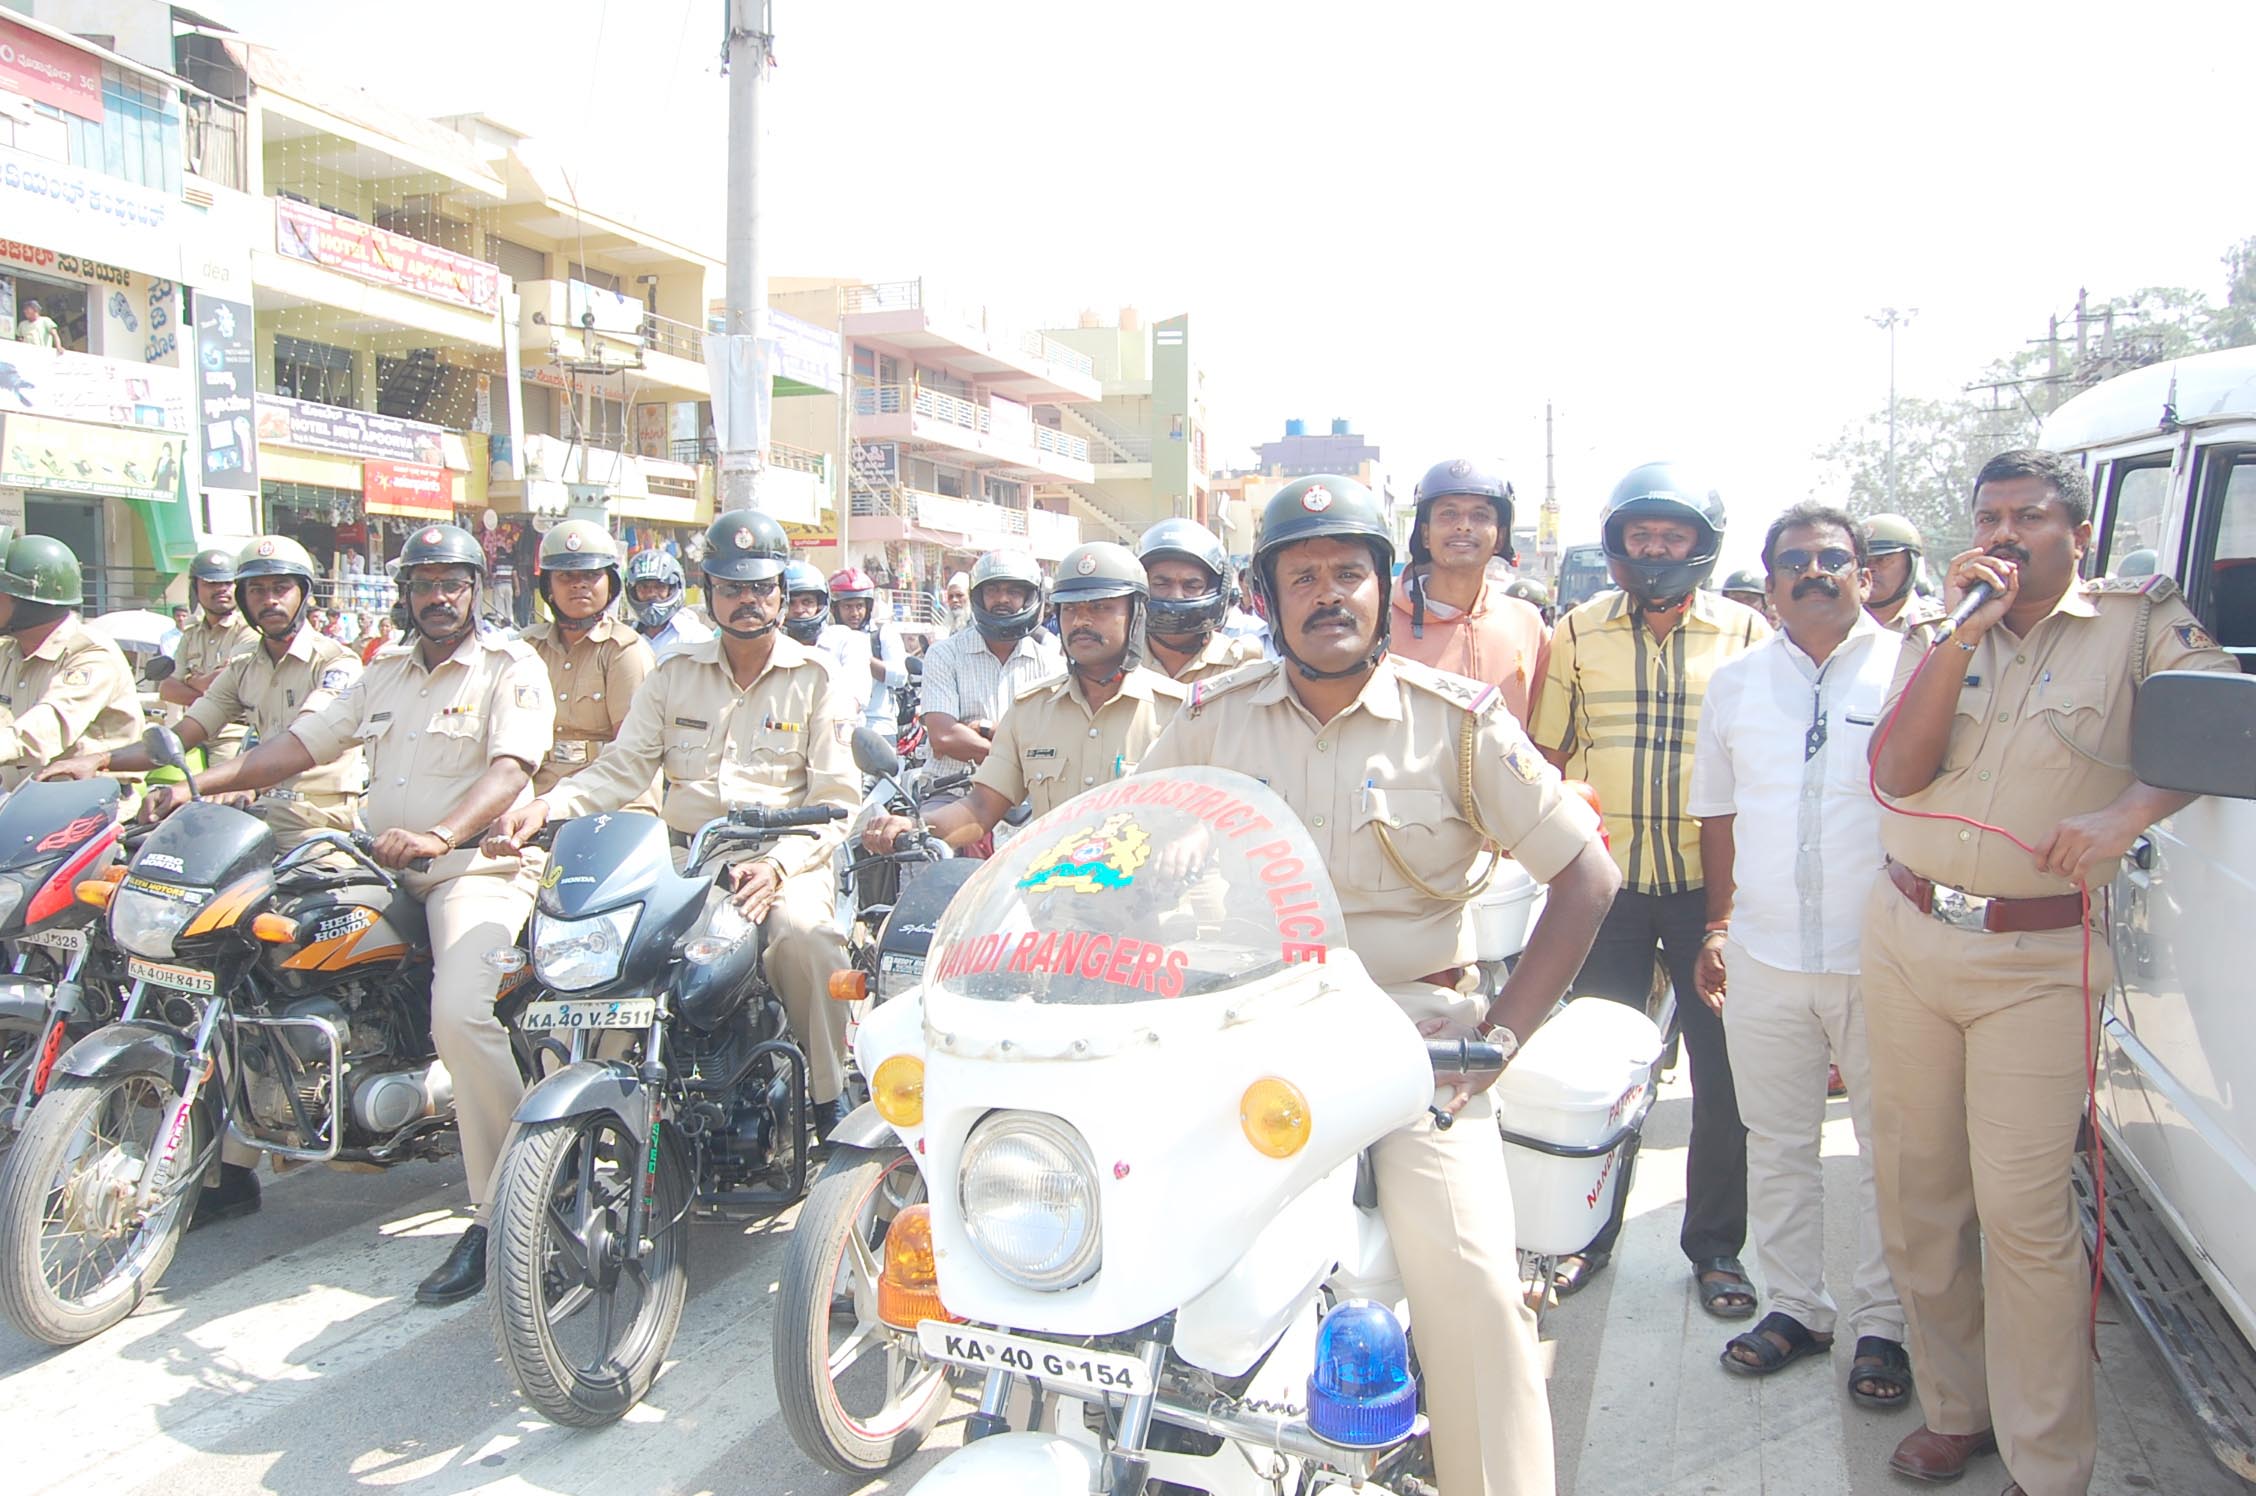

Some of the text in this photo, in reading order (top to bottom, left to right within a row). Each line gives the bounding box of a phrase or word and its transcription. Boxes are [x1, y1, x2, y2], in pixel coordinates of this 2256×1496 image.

[139, 859, 184, 874] HONDA
[146, 853, 185, 865] HERO
[560, 876, 596, 885] HONDA
[1136, 780, 1274, 840] DISTRICT
[1246, 838, 1328, 966] POLICE
[314, 918, 372, 943] HONDA
[319, 909, 366, 932] HERO
[934, 929, 1190, 999] NANDI RANGERS
[944, 1334, 987, 1363] KA
[999, 1345, 1034, 1371] 40
[1079, 1360, 1135, 1389] 154
